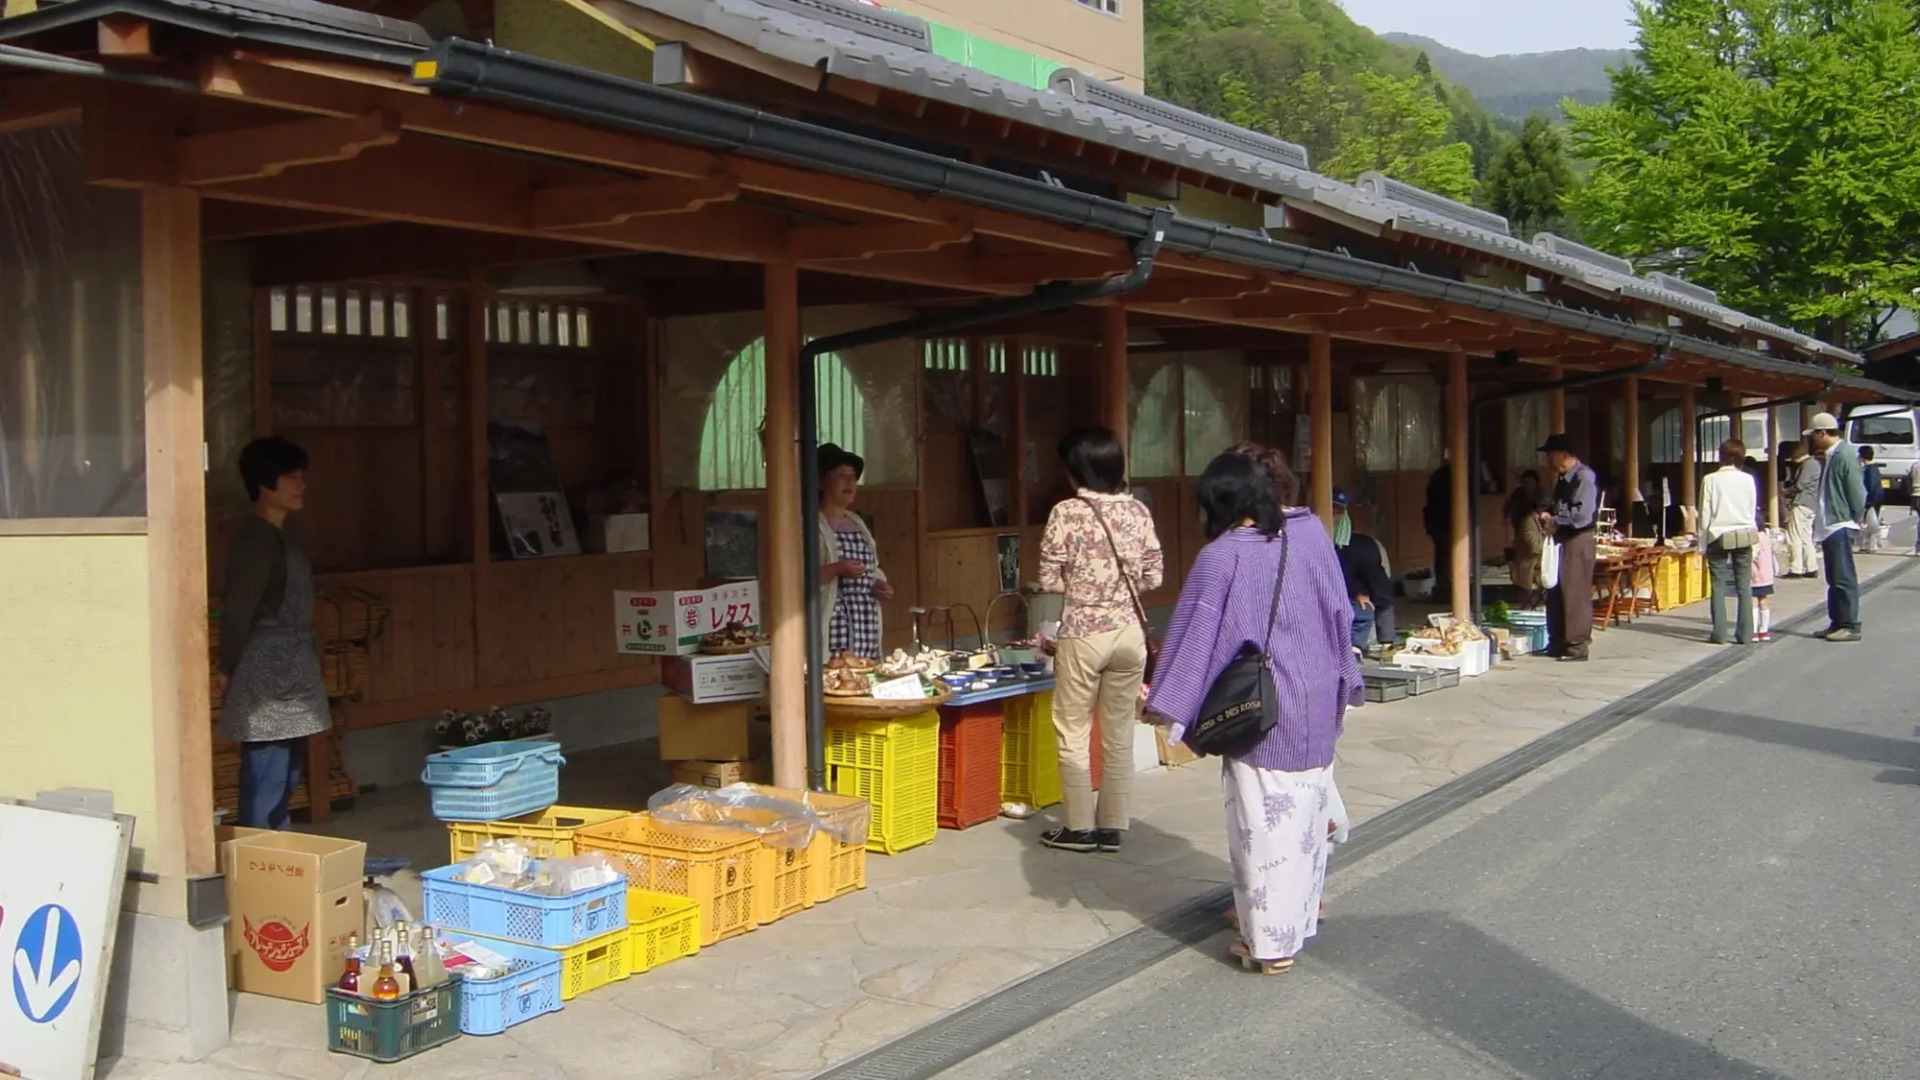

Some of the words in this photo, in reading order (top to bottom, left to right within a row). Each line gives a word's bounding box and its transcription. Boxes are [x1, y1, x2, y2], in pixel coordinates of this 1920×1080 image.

[685, 608, 699, 627] 岩
[711, 602, 753, 630] レタス
